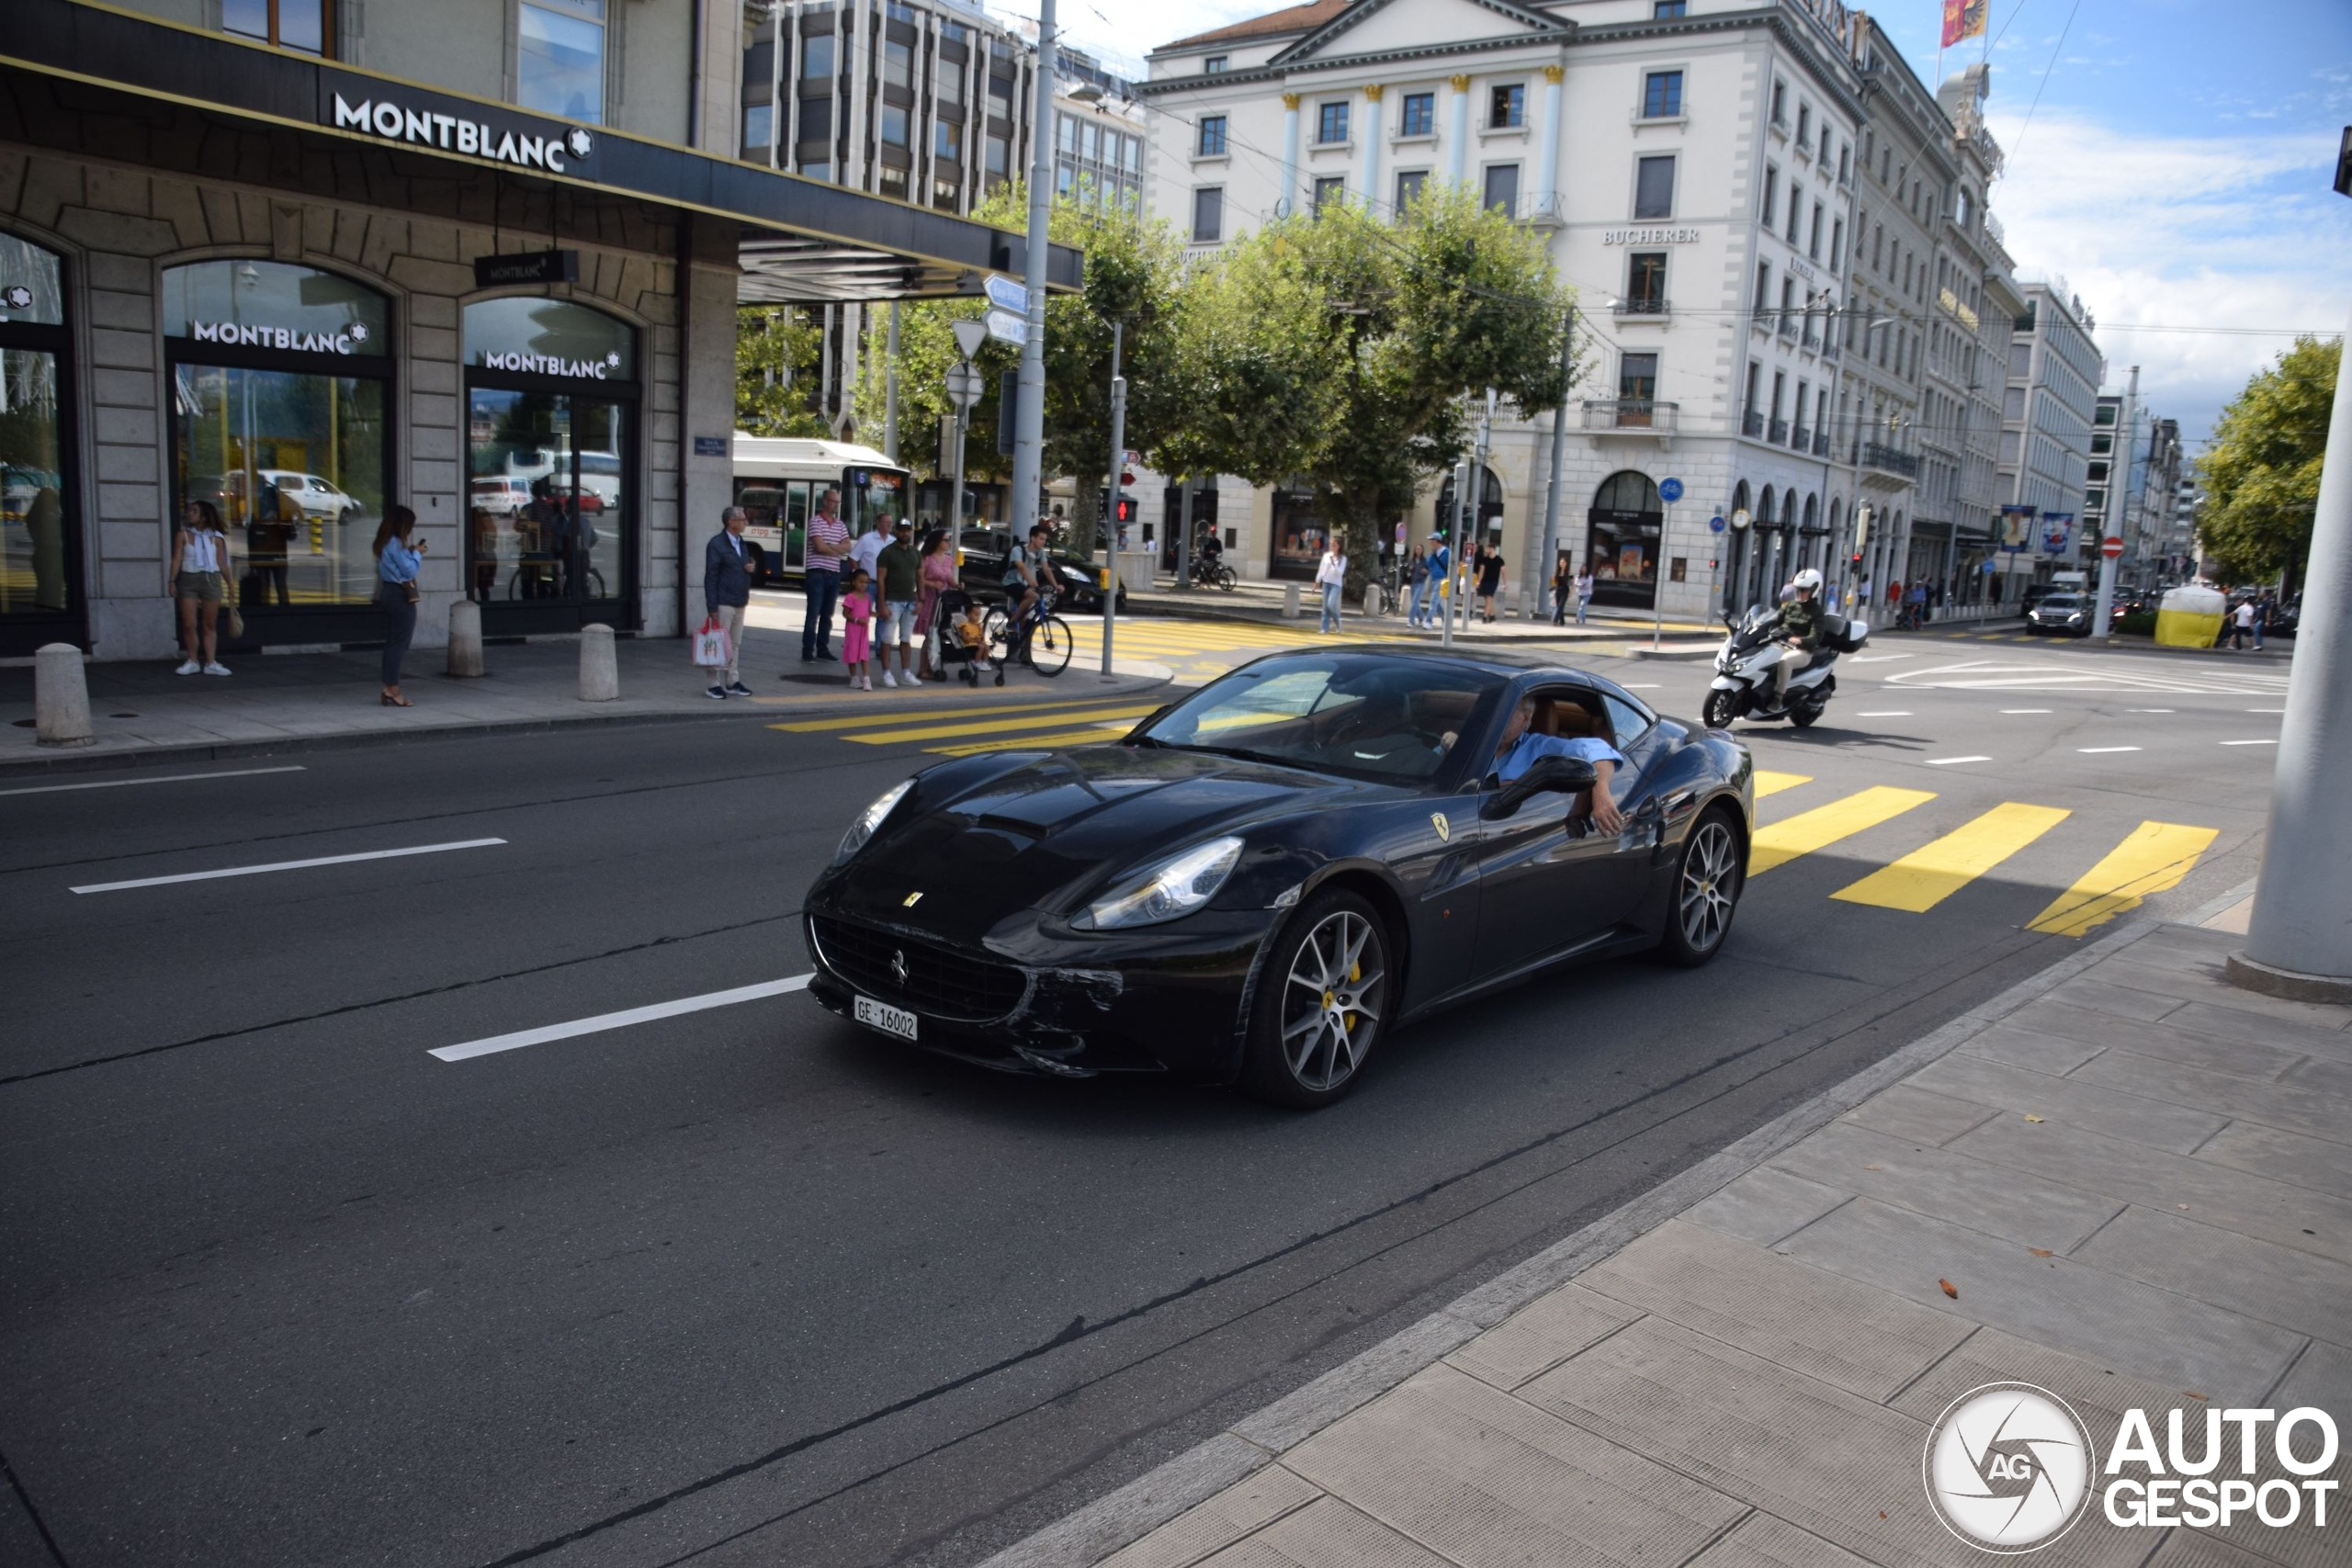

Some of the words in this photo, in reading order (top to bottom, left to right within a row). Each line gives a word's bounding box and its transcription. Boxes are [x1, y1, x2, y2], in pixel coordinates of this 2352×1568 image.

[334, 92, 565, 173] MONTBLANC
[1602, 228, 1700, 245] BUCHERER
[490, 264, 541, 278] MONTBLANC
[194, 320, 351, 355] MONTBLANC
[486, 350, 606, 380] MONTBLANC
